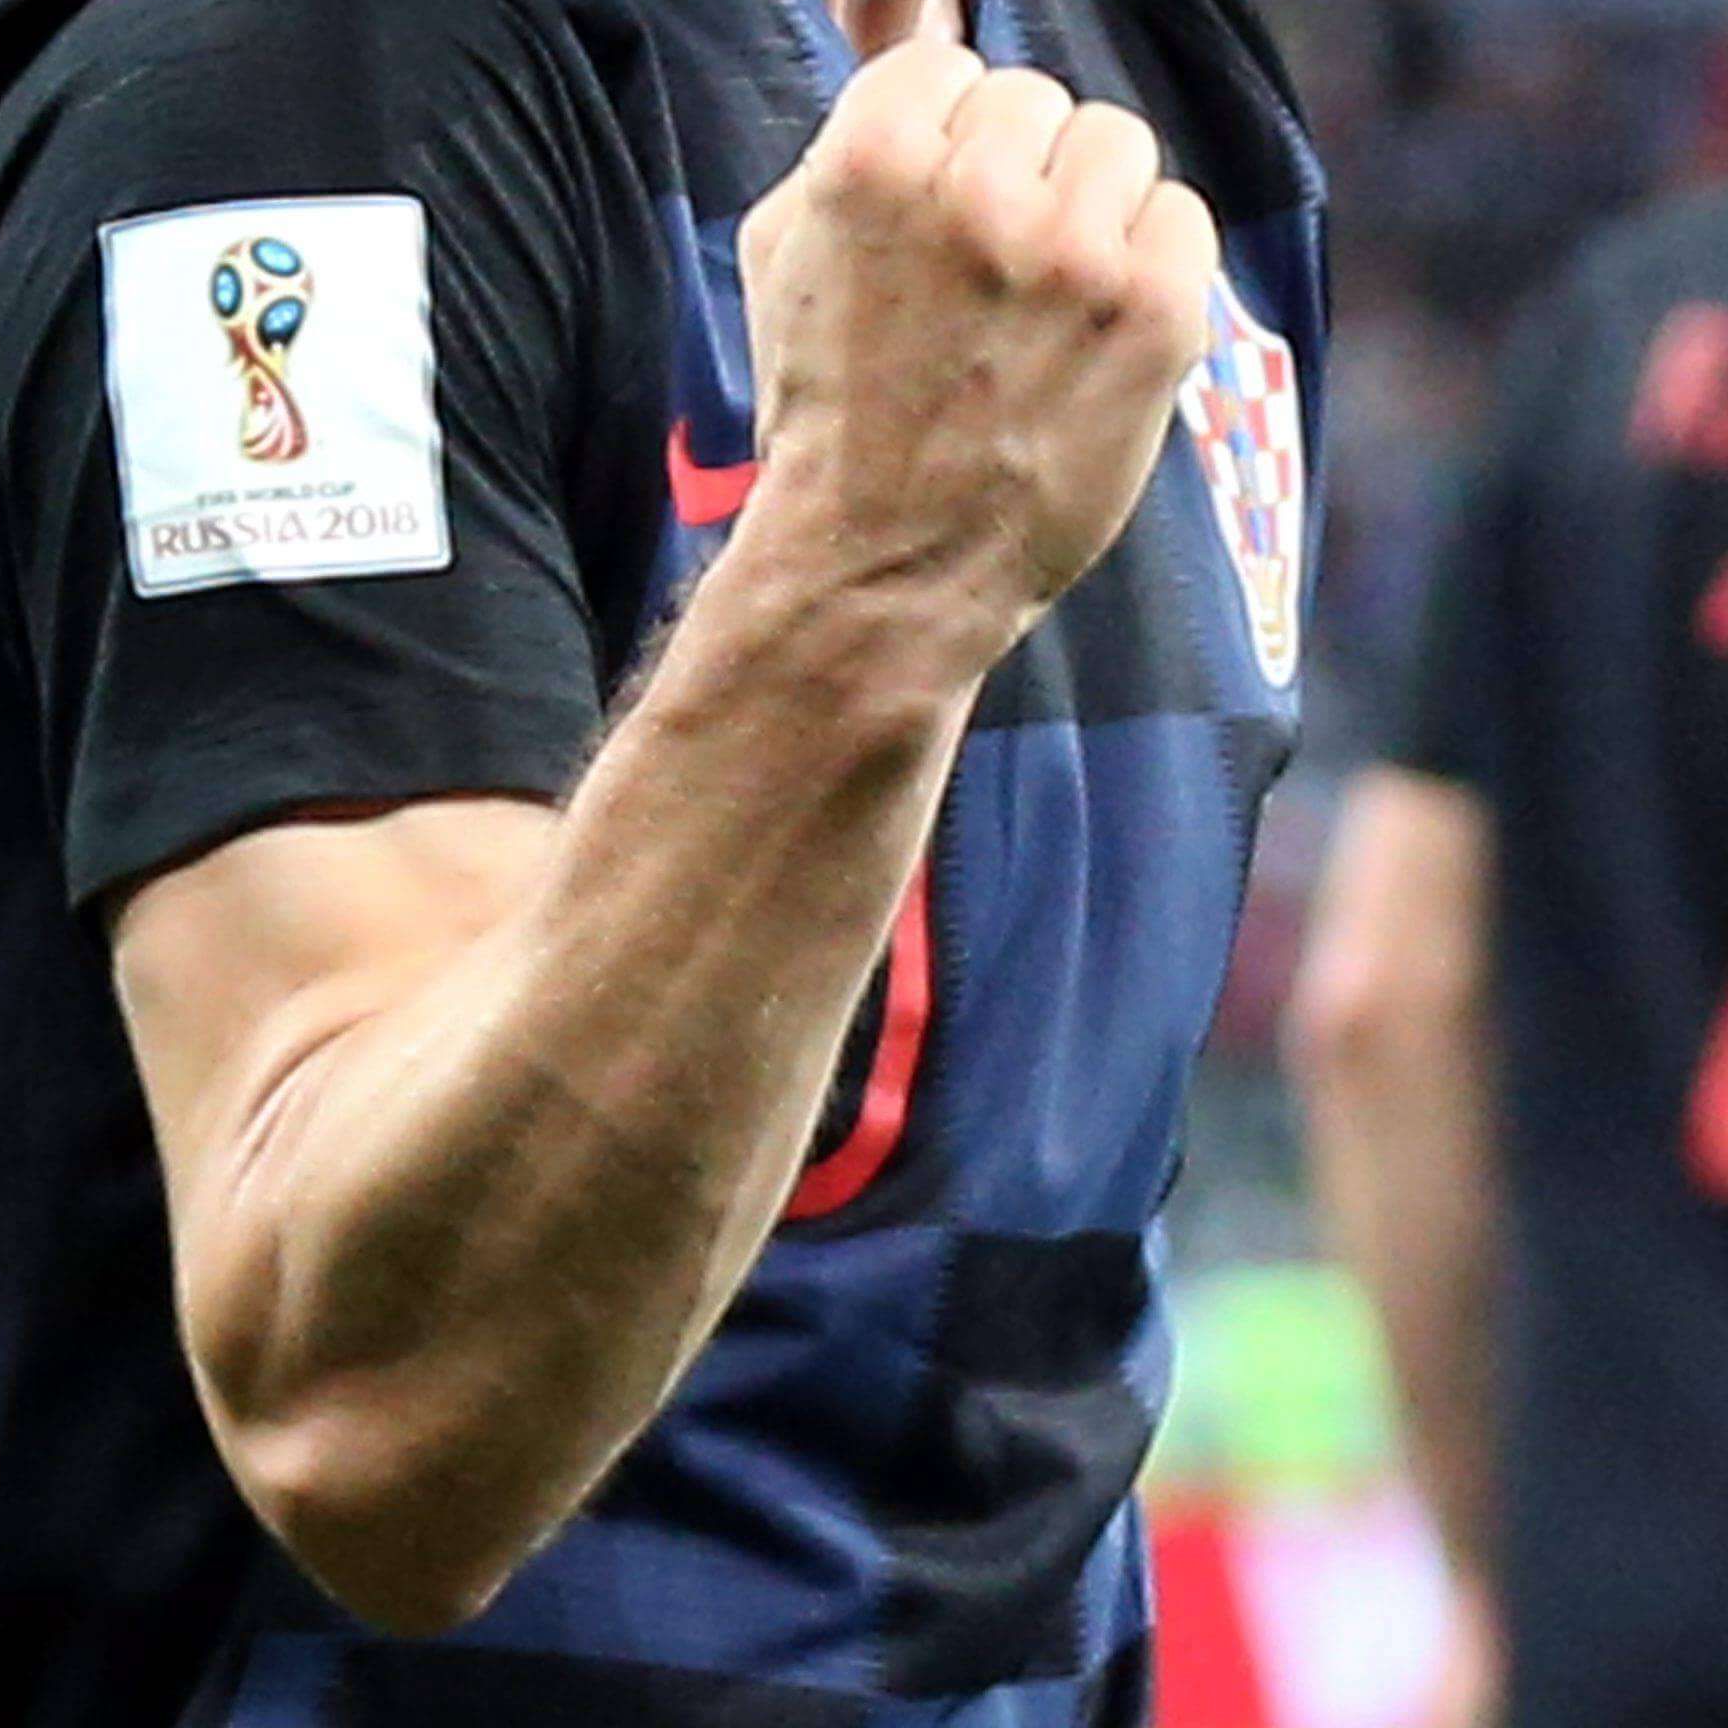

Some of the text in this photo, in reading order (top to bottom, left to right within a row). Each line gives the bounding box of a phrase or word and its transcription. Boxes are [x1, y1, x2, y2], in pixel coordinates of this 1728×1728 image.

[244, 484, 314, 502] WORLD
[316, 481, 355, 498] CUP
[151, 501, 420, 558] RUSSIA 2018
